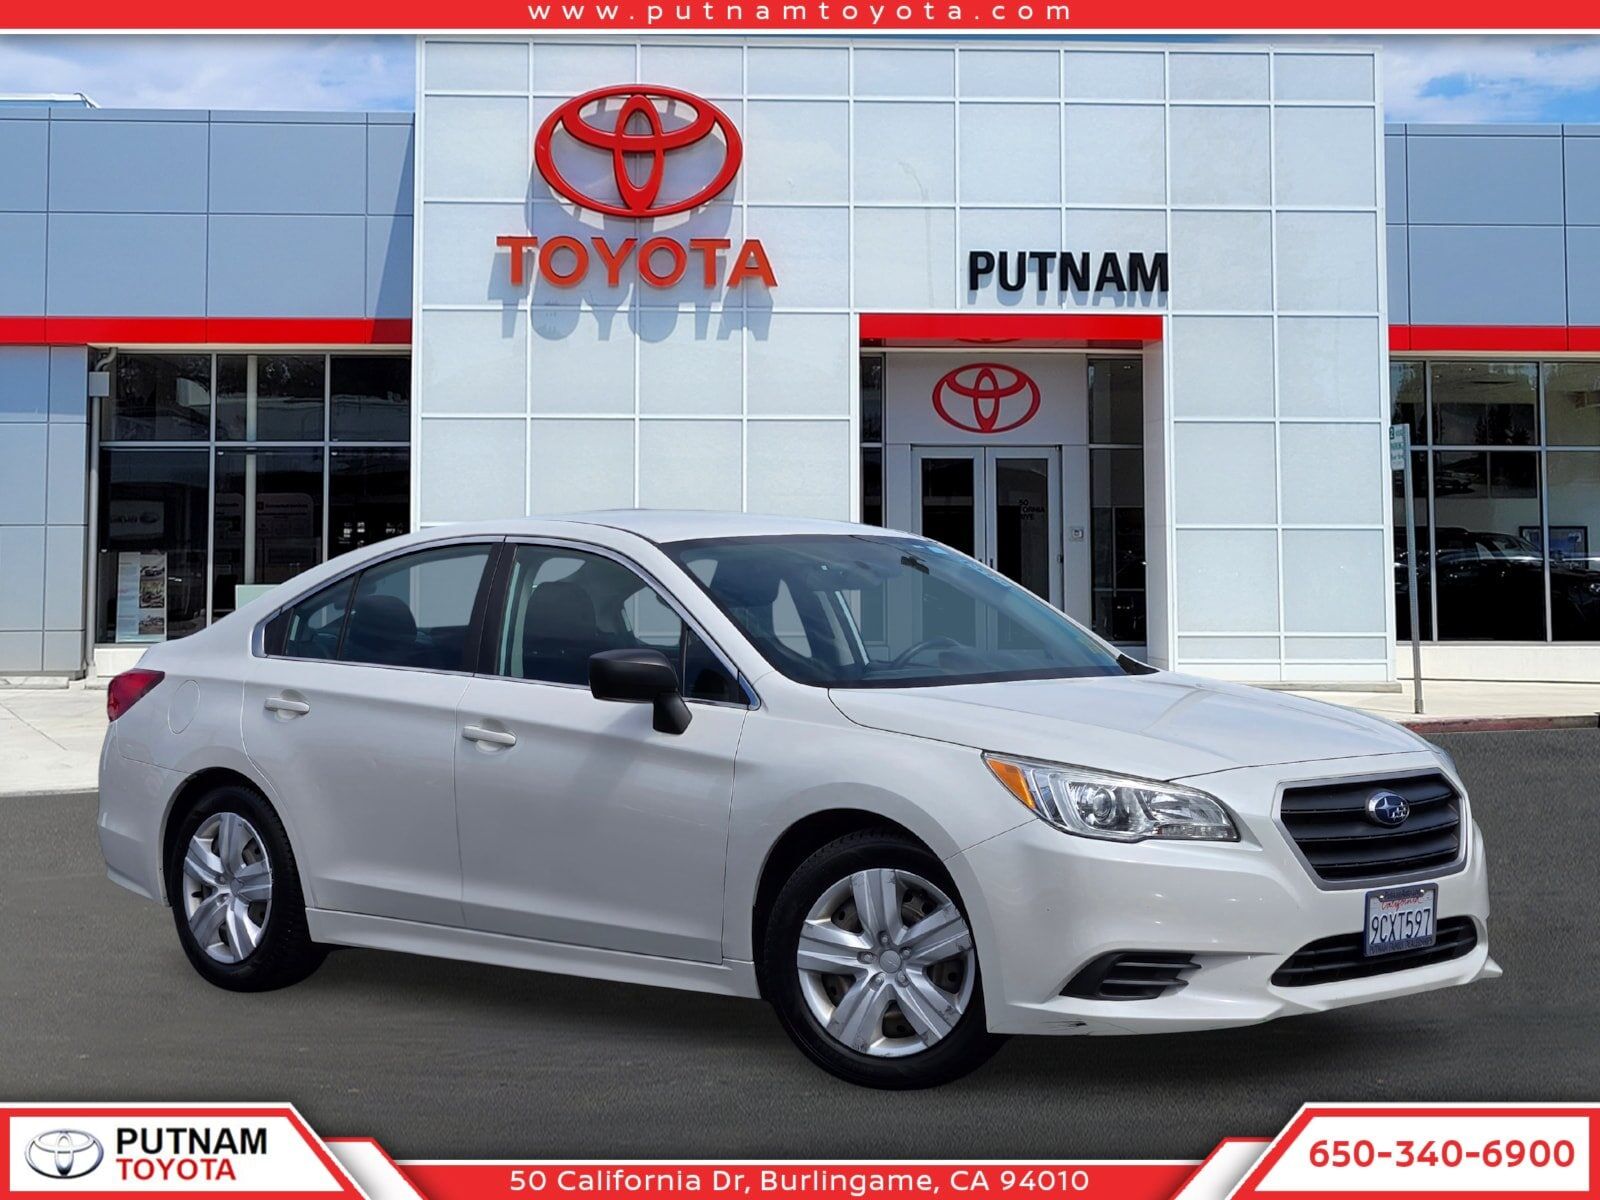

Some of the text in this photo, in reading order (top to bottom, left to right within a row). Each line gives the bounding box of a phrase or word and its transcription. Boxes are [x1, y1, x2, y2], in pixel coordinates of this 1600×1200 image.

[497, 236, 777, 288] TOYOTA
[969, 251, 1169, 292] PUTNAM
[1371, 908, 1431, 945] 9CXT597
